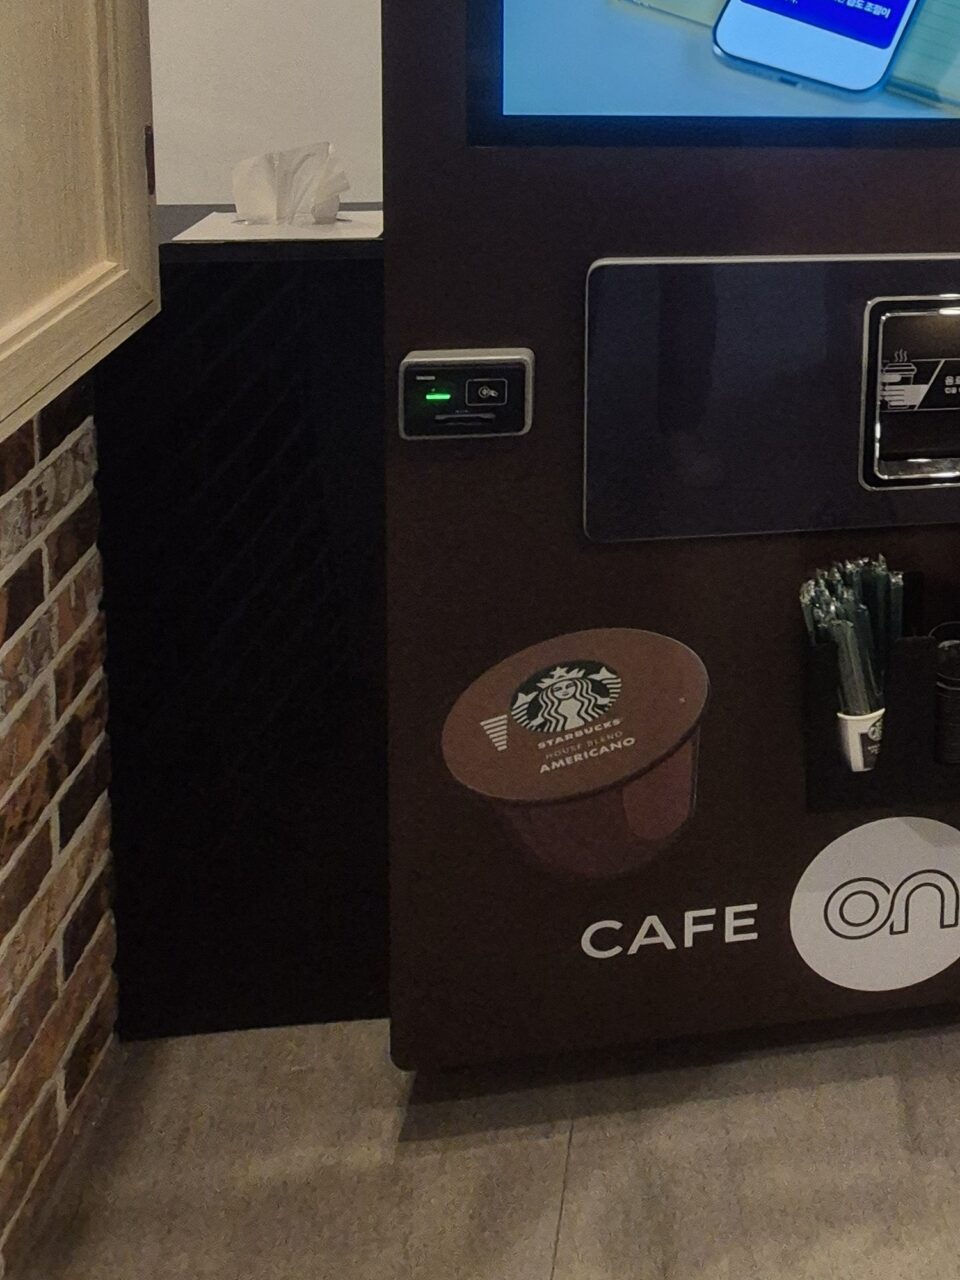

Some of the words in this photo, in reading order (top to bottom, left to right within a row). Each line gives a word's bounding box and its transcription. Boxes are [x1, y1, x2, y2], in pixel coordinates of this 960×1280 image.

[537, 718, 621, 750] STARBUCKS
[539, 736, 636, 774] AMERICANO
[580, 902, 759, 959] CAFE
